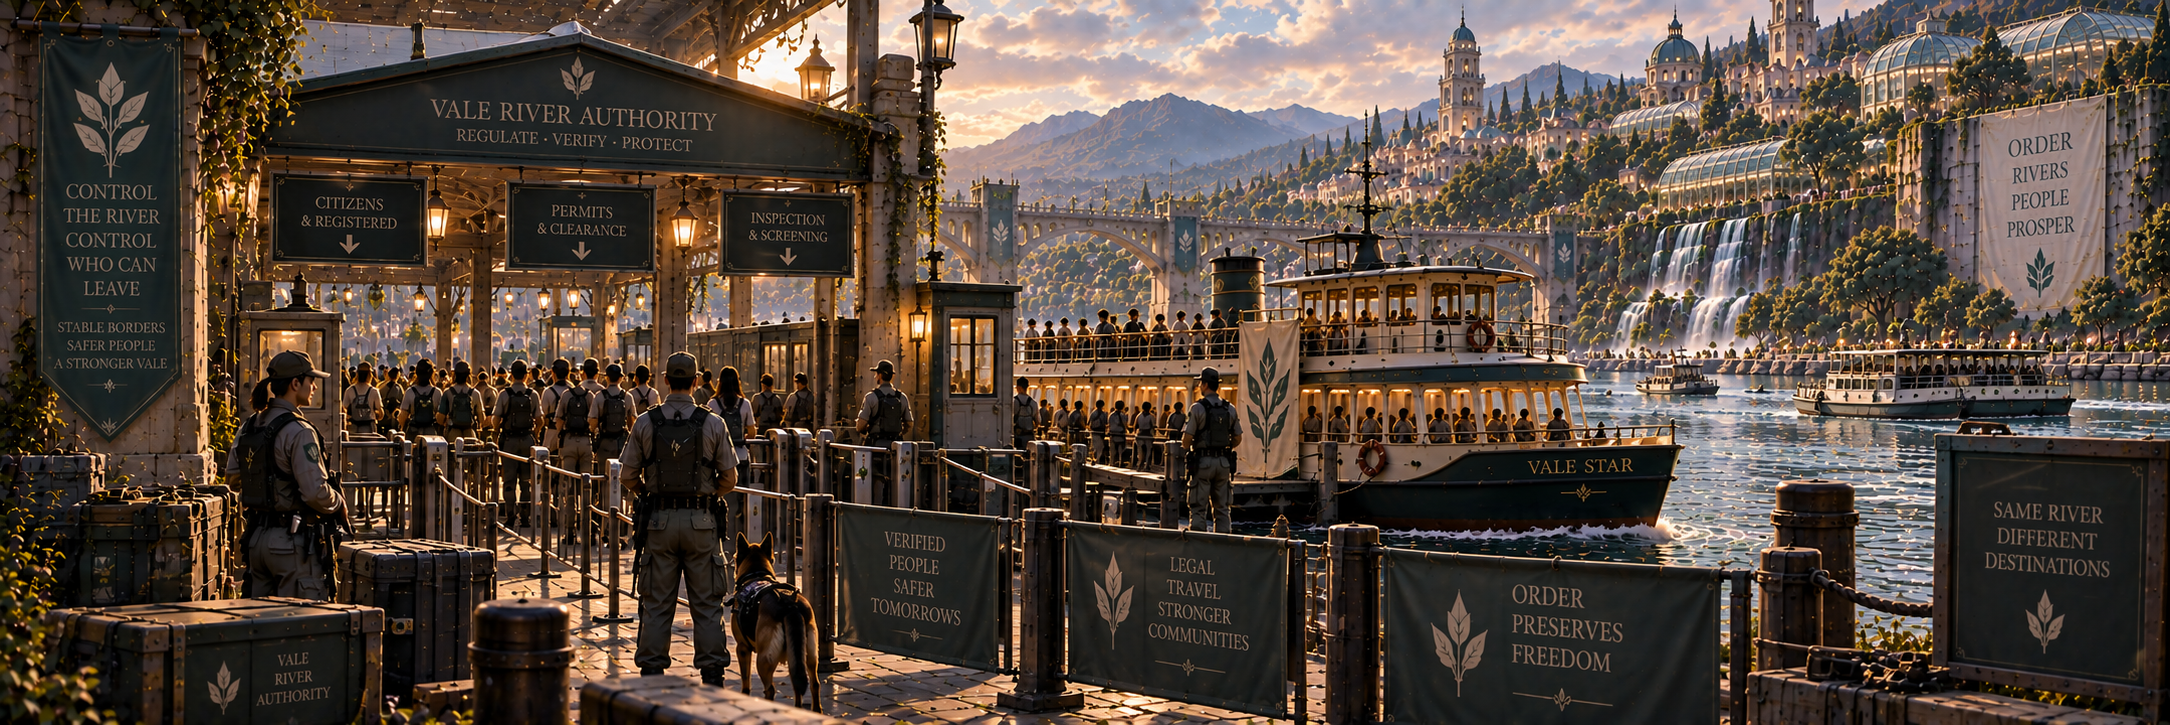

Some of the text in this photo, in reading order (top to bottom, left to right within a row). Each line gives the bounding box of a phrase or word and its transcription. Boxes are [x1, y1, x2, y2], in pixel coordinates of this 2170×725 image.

[430, 98, 718, 131] VALE RIVER AUTHORITY
[456, 128, 539, 144] REGULATE
[552, 132, 608, 147] VERIFY
[622, 136, 693, 151] PROTECT
[2008, 131, 2074, 157] ORDER
[2012, 160, 2069, 184] RIVERS
[65, 183, 158, 200] CONTROL
[2011, 188, 2070, 210] PEOPLE
[315, 196, 384, 210] CITIZENS
[551, 204, 613, 218] PERMITS
[62, 207, 161, 224] THE RIVER
[300, 214, 398, 229] & REGISTERED
[751, 212, 825, 225] INSPECTION
[537, 222, 627, 236] & CLEARANCE
[748, 229, 828, 242] & SCREENING
[2007, 215, 2075, 237] PROSPER
[65, 232, 157, 248] CONTROL
[66, 256, 157, 272] WHO CAN
[83, 280, 141, 296] LEAVE
[57, 321, 166, 333] STABLE BORDERS
[66, 339, 156, 352] SAFER PEOPLE
[53, 357, 168, 370] A STRONGER VALE
[1527, 457, 1634, 474] VALE STAR
[1993, 501, 2104, 523] SAME RIVER
[884, 530, 946, 552] VERIFIED
[1997, 527, 2098, 550] DIFFERENT
[889, 554, 940, 574] PEOPLE
[1170, 556, 1216, 575] LEGAL
[1984, 551, 2110, 577] DESTINATIONS
[893, 577, 935, 598] SAFER
[1166, 578, 1222, 599] TRAVEL
[1512, 583, 1585, 608] ORDER
[871, 597, 962, 626] TOMORROWS
[1158, 601, 1232, 625] STRONGER
[1148, 622, 1250, 652] COMMUNITIES
[1512, 613, 1624, 643] PRESERVES
[277, 652, 309, 666] VALE
[1512, 643, 1612, 673] FREEDOM
[274, 670, 313, 685] RIVER
[256, 686, 331, 706] AUTHORITY
